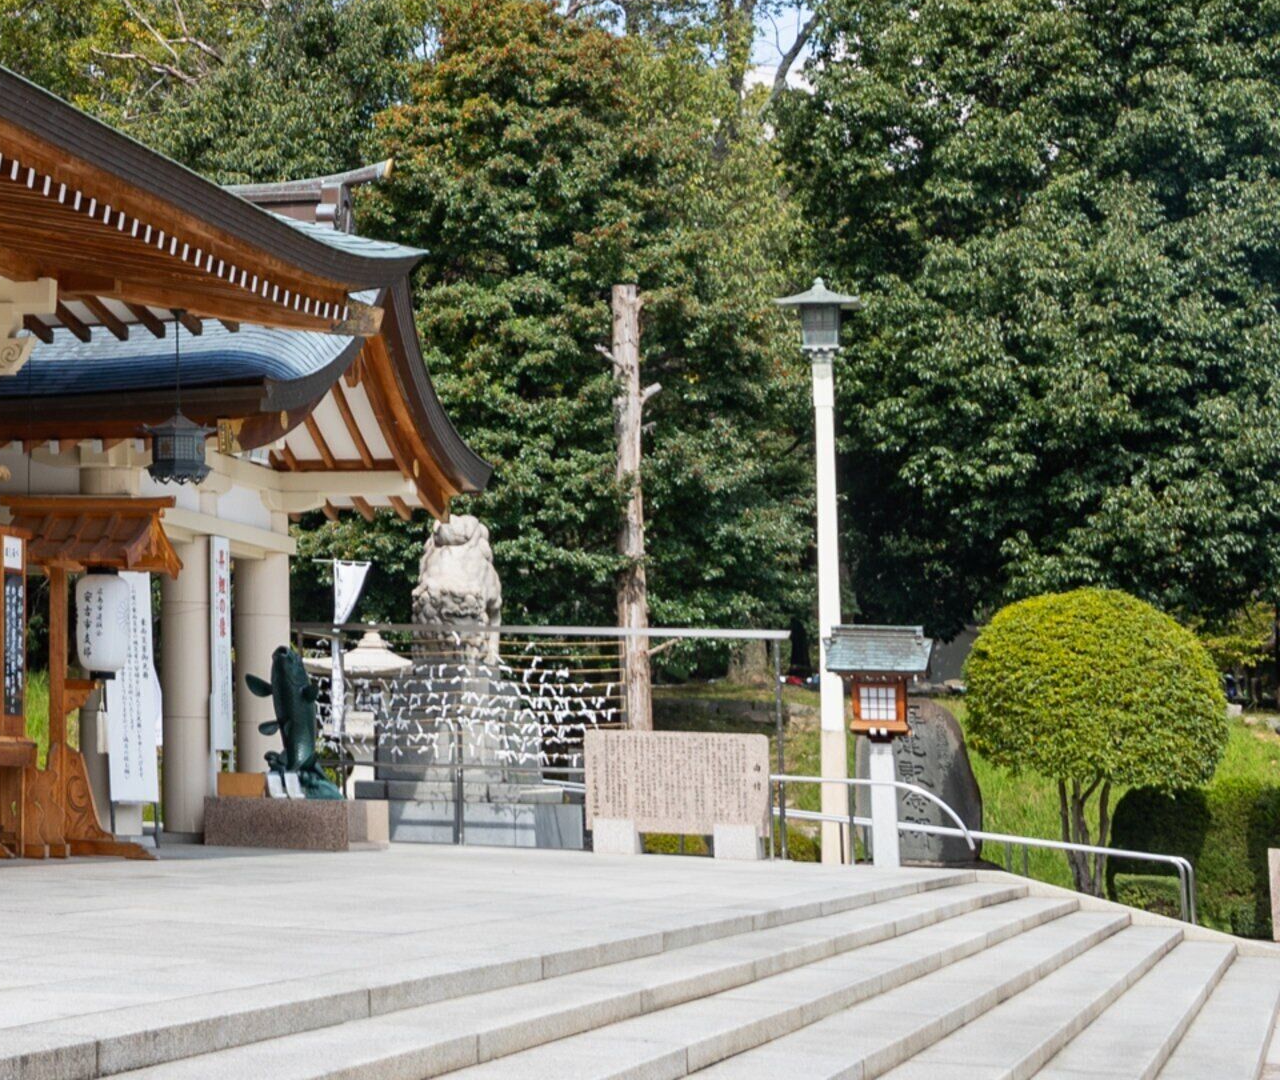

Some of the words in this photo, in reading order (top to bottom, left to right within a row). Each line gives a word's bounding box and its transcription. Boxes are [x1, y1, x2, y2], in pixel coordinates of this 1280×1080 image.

[83, 590, 94, 659] 安古市支部
